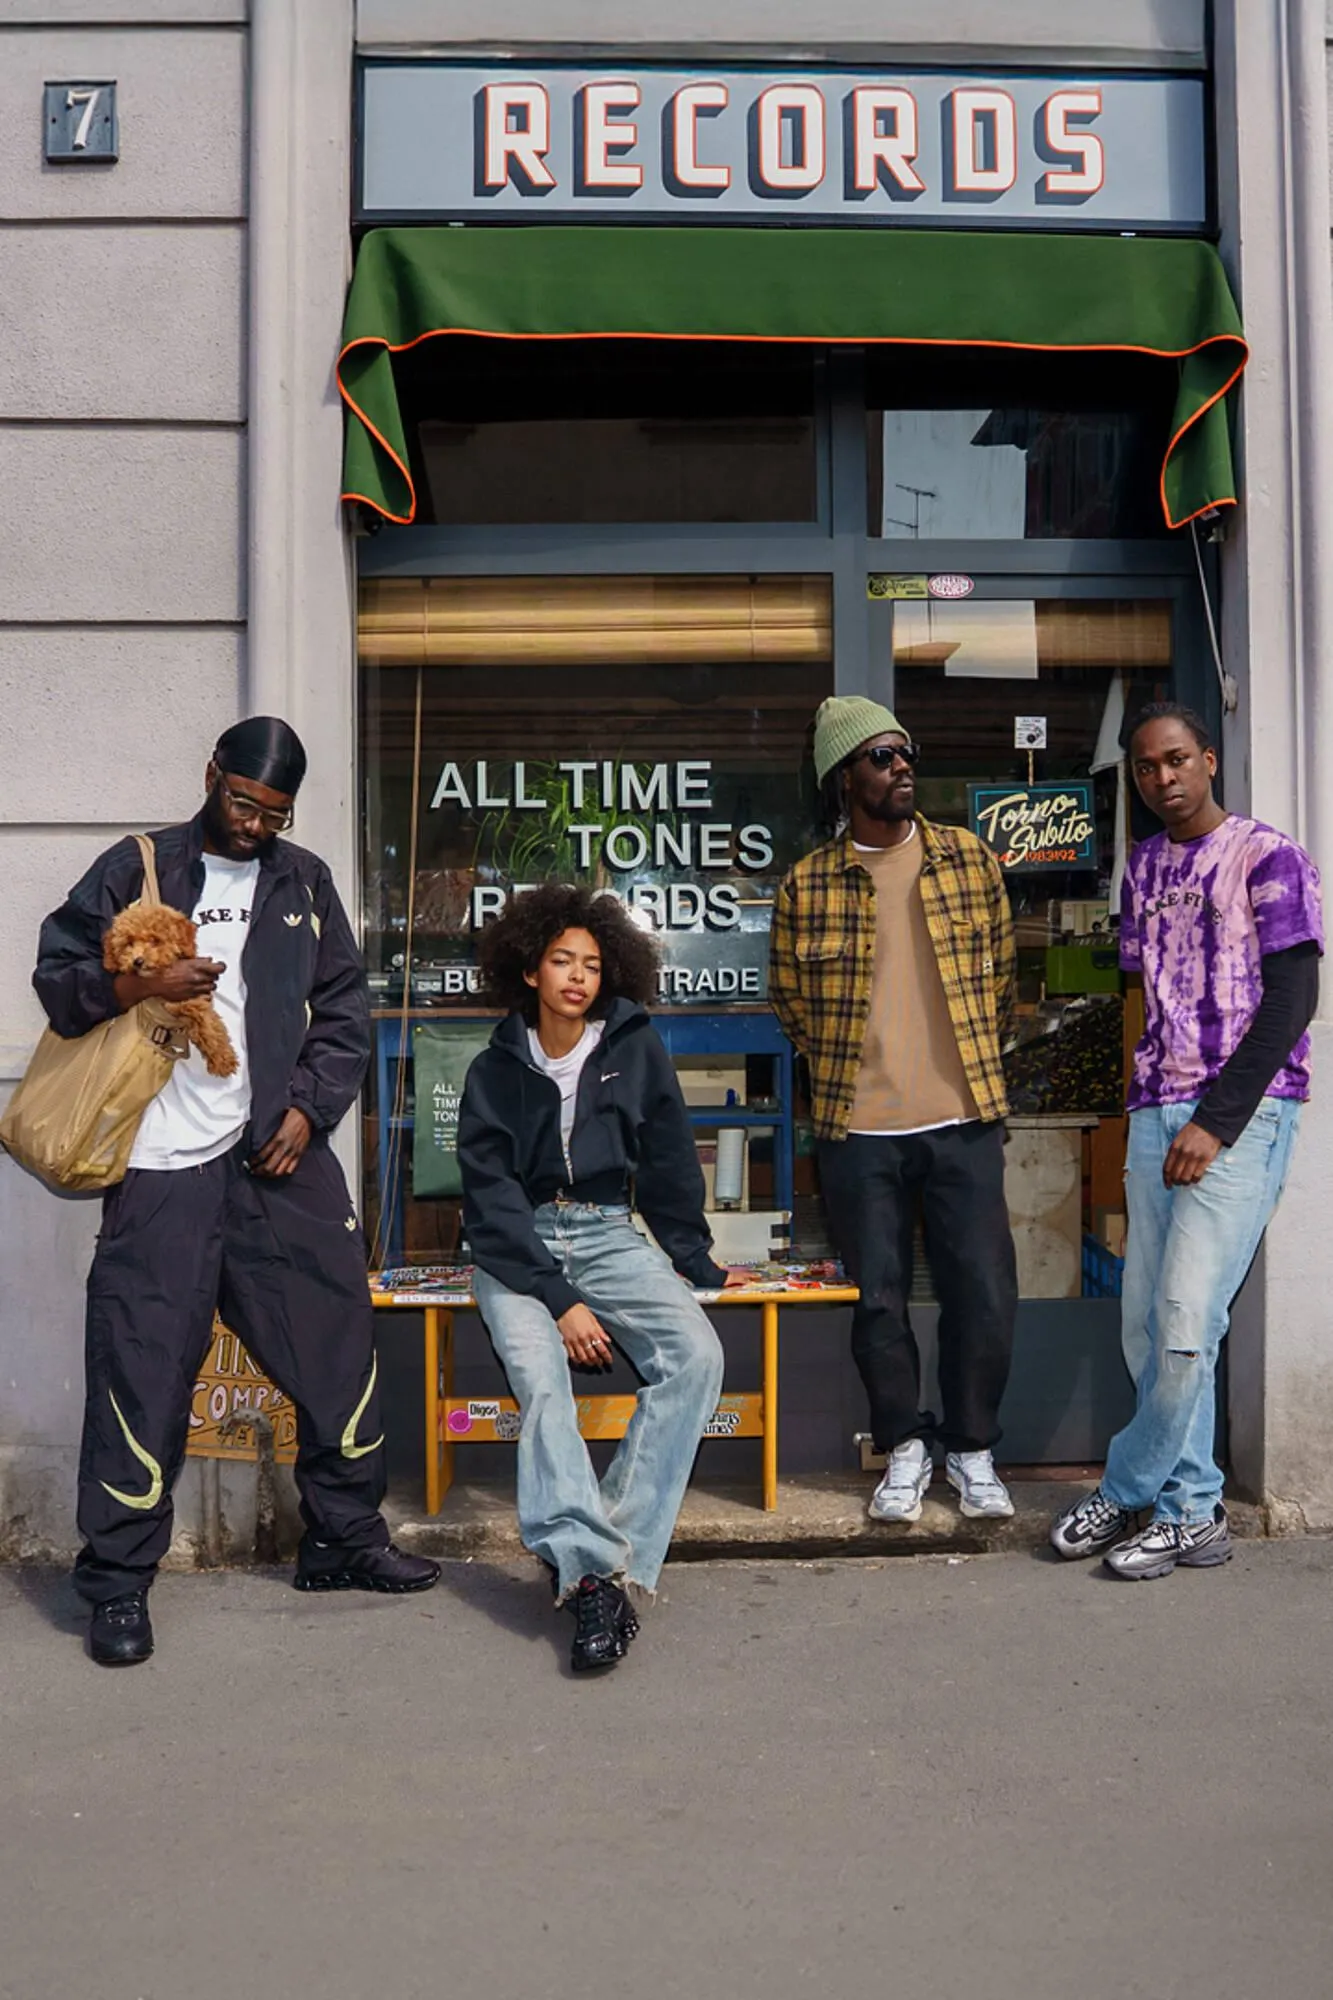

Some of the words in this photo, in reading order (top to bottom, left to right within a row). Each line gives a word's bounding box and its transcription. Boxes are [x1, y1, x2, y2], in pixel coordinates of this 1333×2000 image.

[66, 88, 100, 149] 7
[474, 80, 1104, 205] RECORDS
[431, 760, 548, 810] ALL
[558, 760, 713, 811] TIME
[977, 792, 1078, 843] Torno
[1004, 810, 1094, 868] Subito
[567, 822, 774, 870] TONES
[197, 908, 233, 926] KE
[473, 884, 742, 929] RRDS
[444, 969, 484, 995] BU
[657, 967, 760, 993] TRADE
[432, 1083, 457, 1095] ALL
[432, 1110, 459, 1123] TON
[189, 1382, 284, 1428] COMPR
